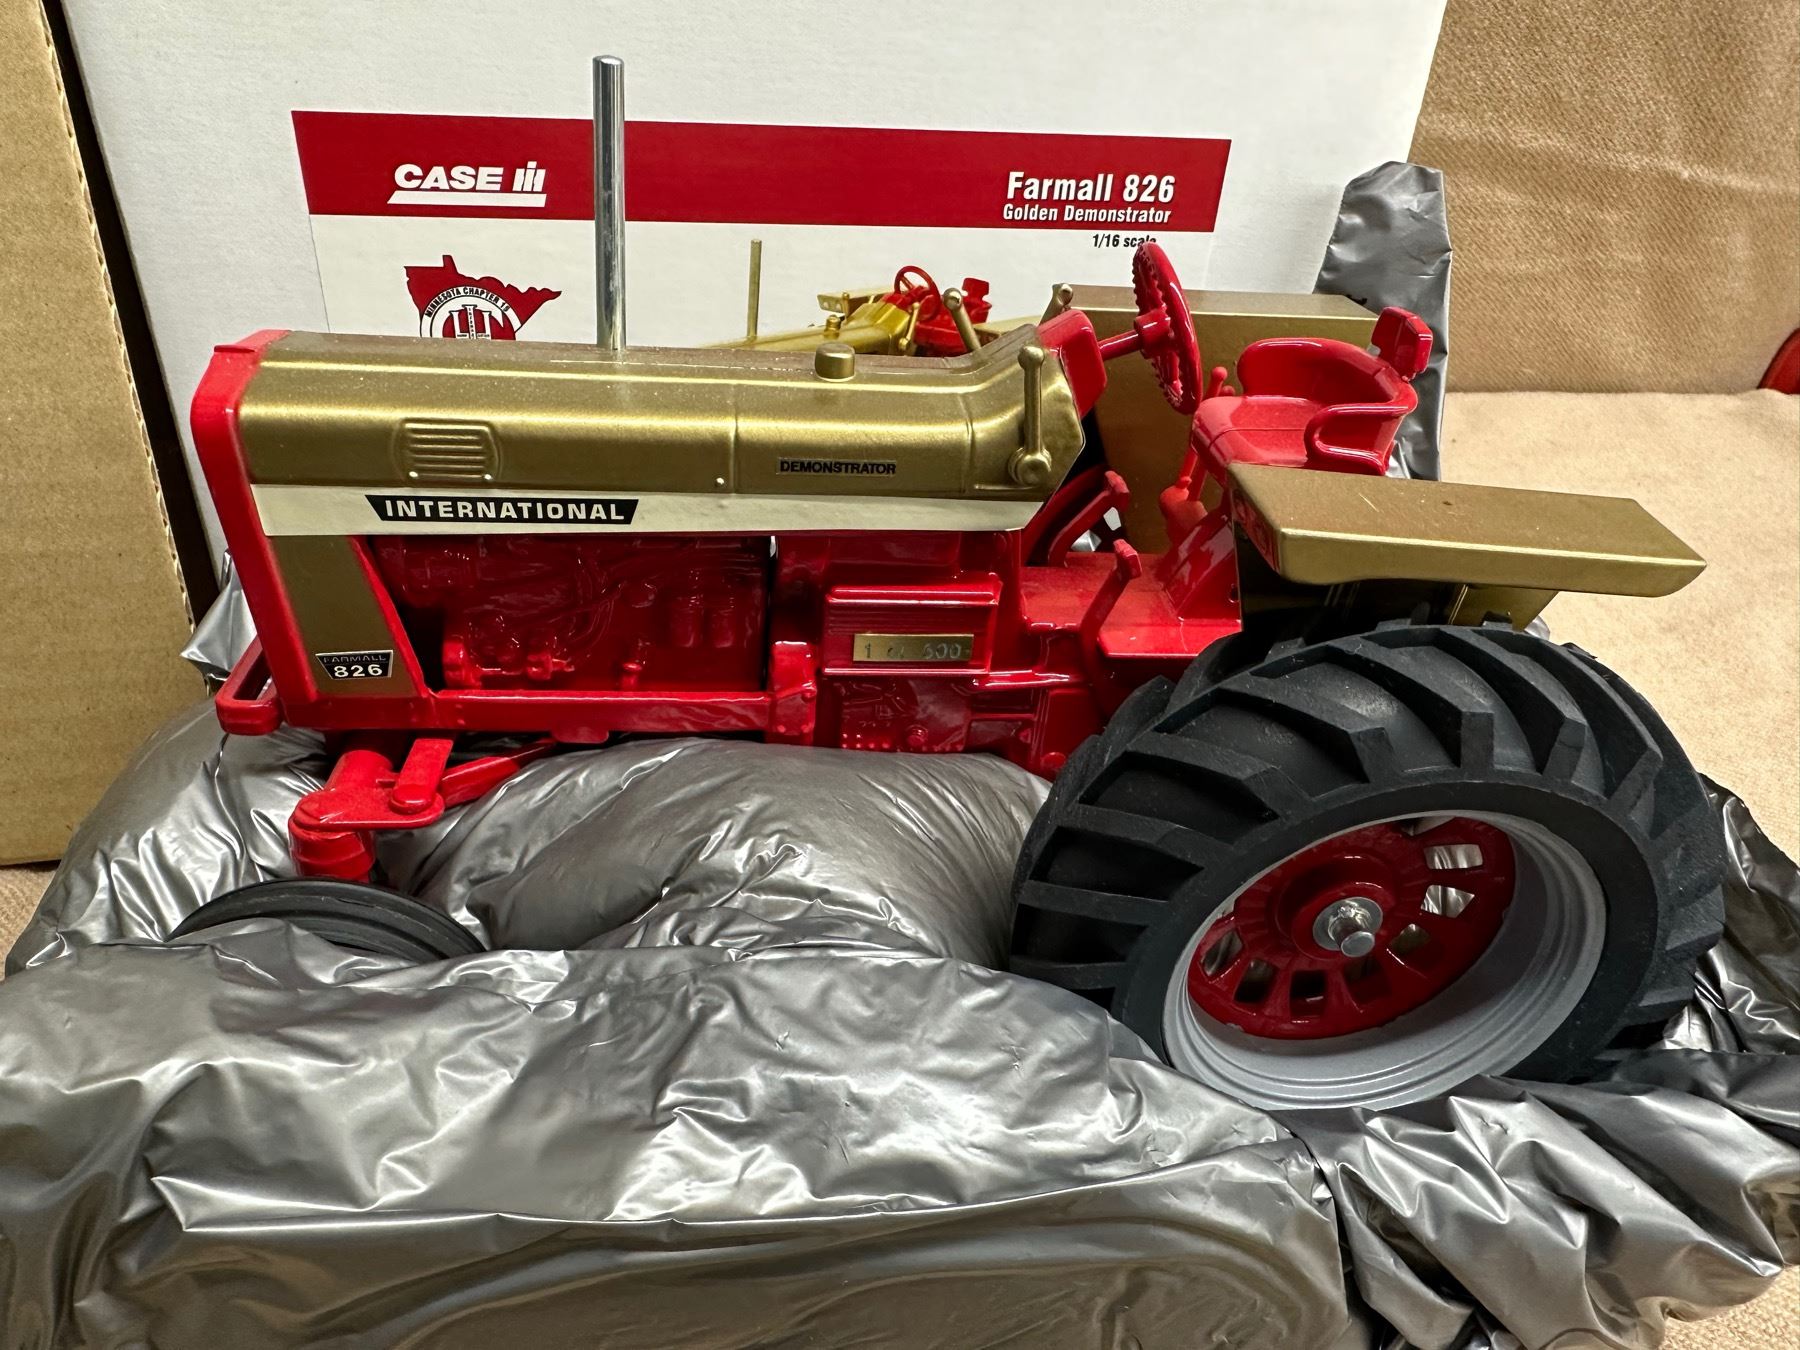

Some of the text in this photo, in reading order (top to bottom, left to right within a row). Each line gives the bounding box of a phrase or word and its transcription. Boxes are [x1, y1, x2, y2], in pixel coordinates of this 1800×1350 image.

[394, 163, 504, 191] CASE
[1007, 171, 1175, 203] Farmall 826
[1003, 203, 1172, 223] Golden Demonstrator
[1092, 233, 1120, 248] 1/16
[424, 288, 462, 318] MINNESOTA
[462, 286, 500, 304] CHAPTER
[780, 460, 896, 474] DEMONSTRATOR
[385, 499, 625, 520] INTERNATIONAL
[323, 654, 387, 663] FARMALL
[333, 664, 383, 678] 826
